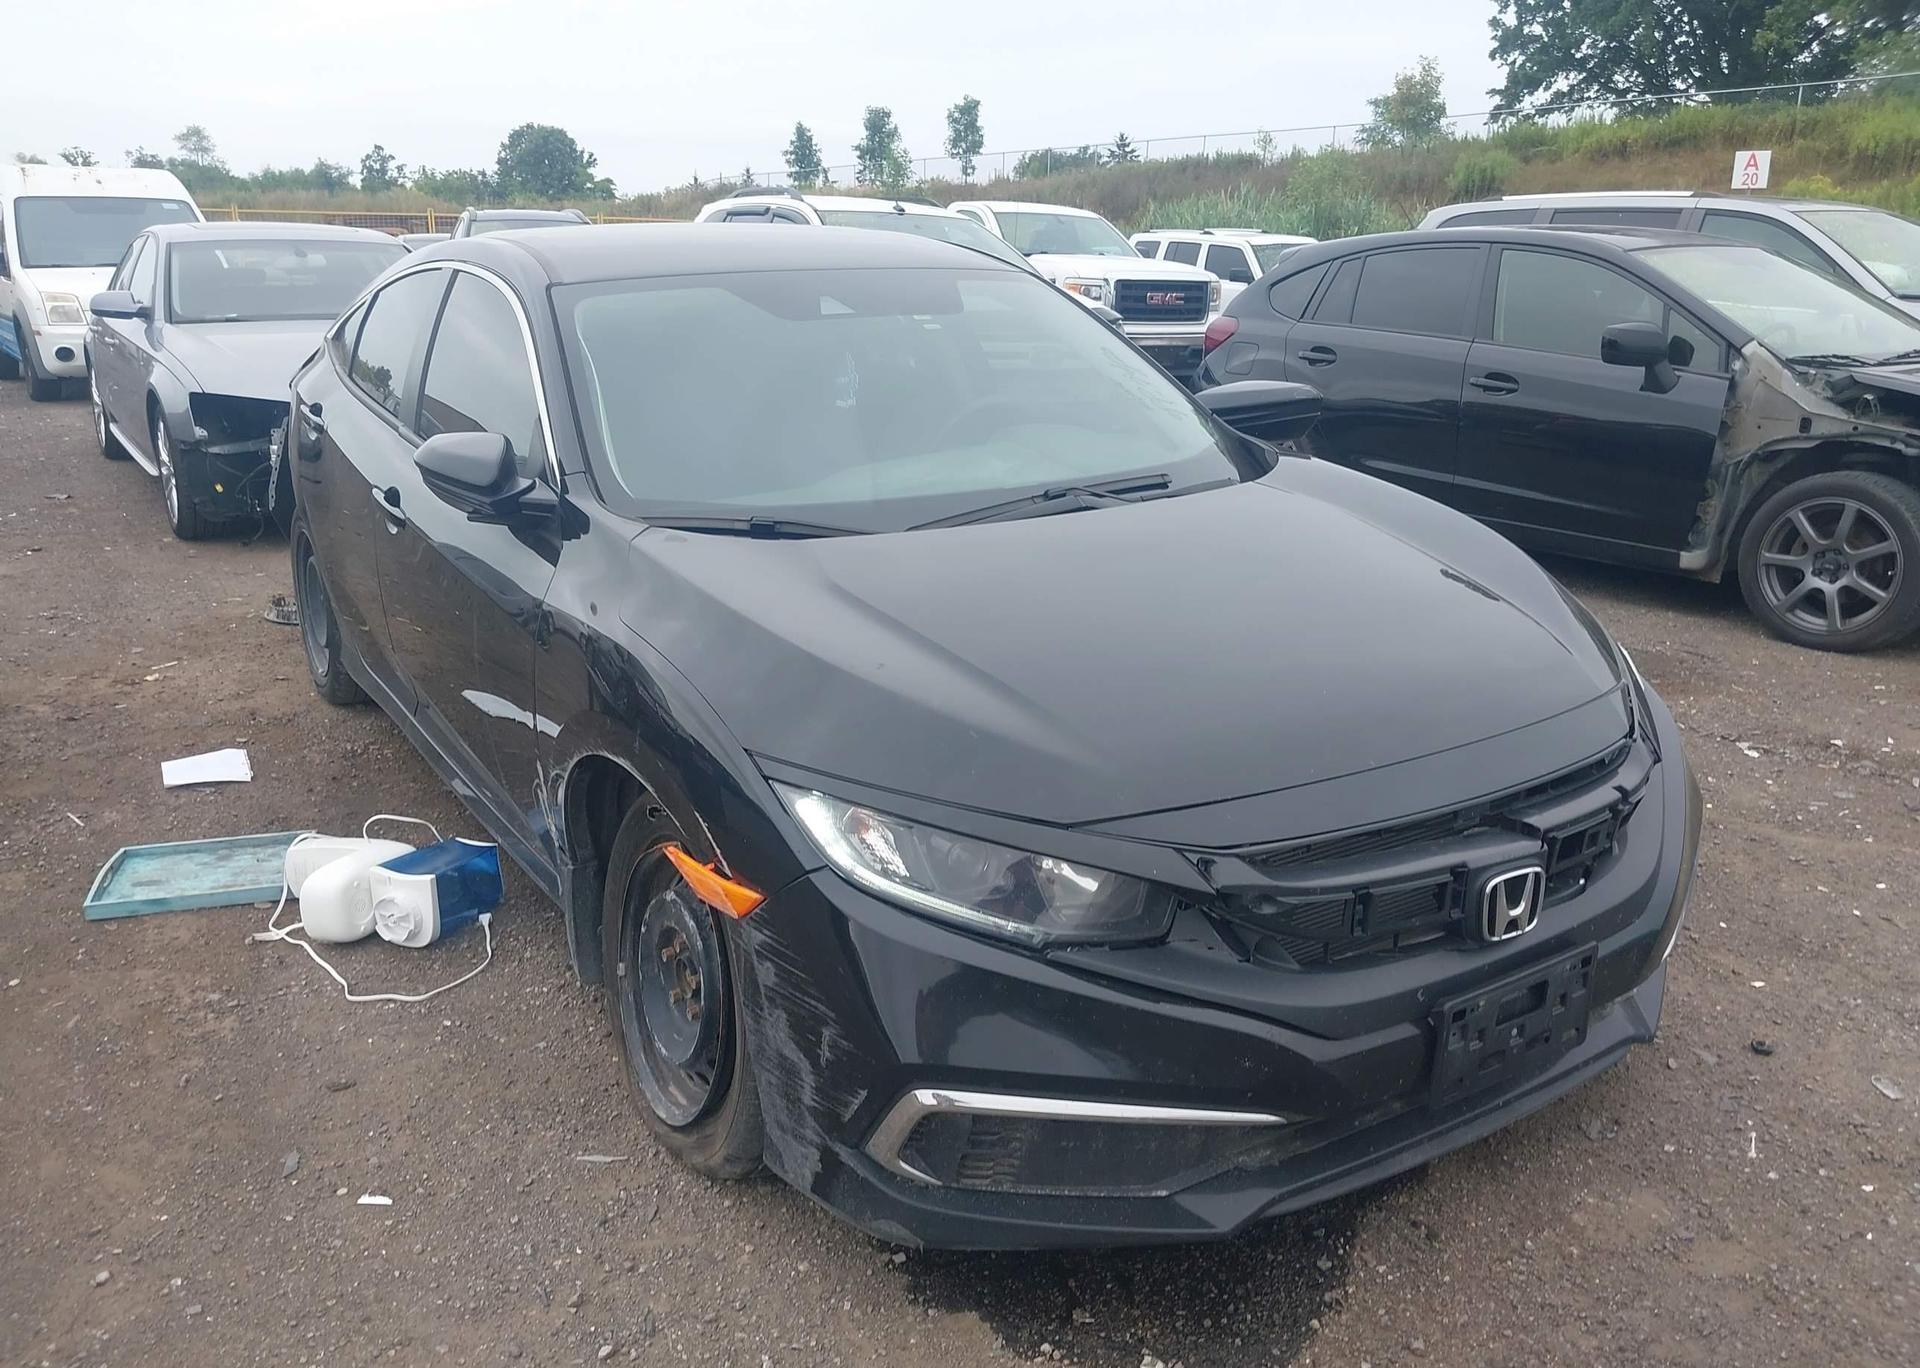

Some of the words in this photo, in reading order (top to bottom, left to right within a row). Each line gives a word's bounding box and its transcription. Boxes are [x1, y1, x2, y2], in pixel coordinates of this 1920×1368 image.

[1744, 152, 1760, 171] A
[1741, 172, 1759, 186] 20
[1146, 292, 1185, 305] GMC
